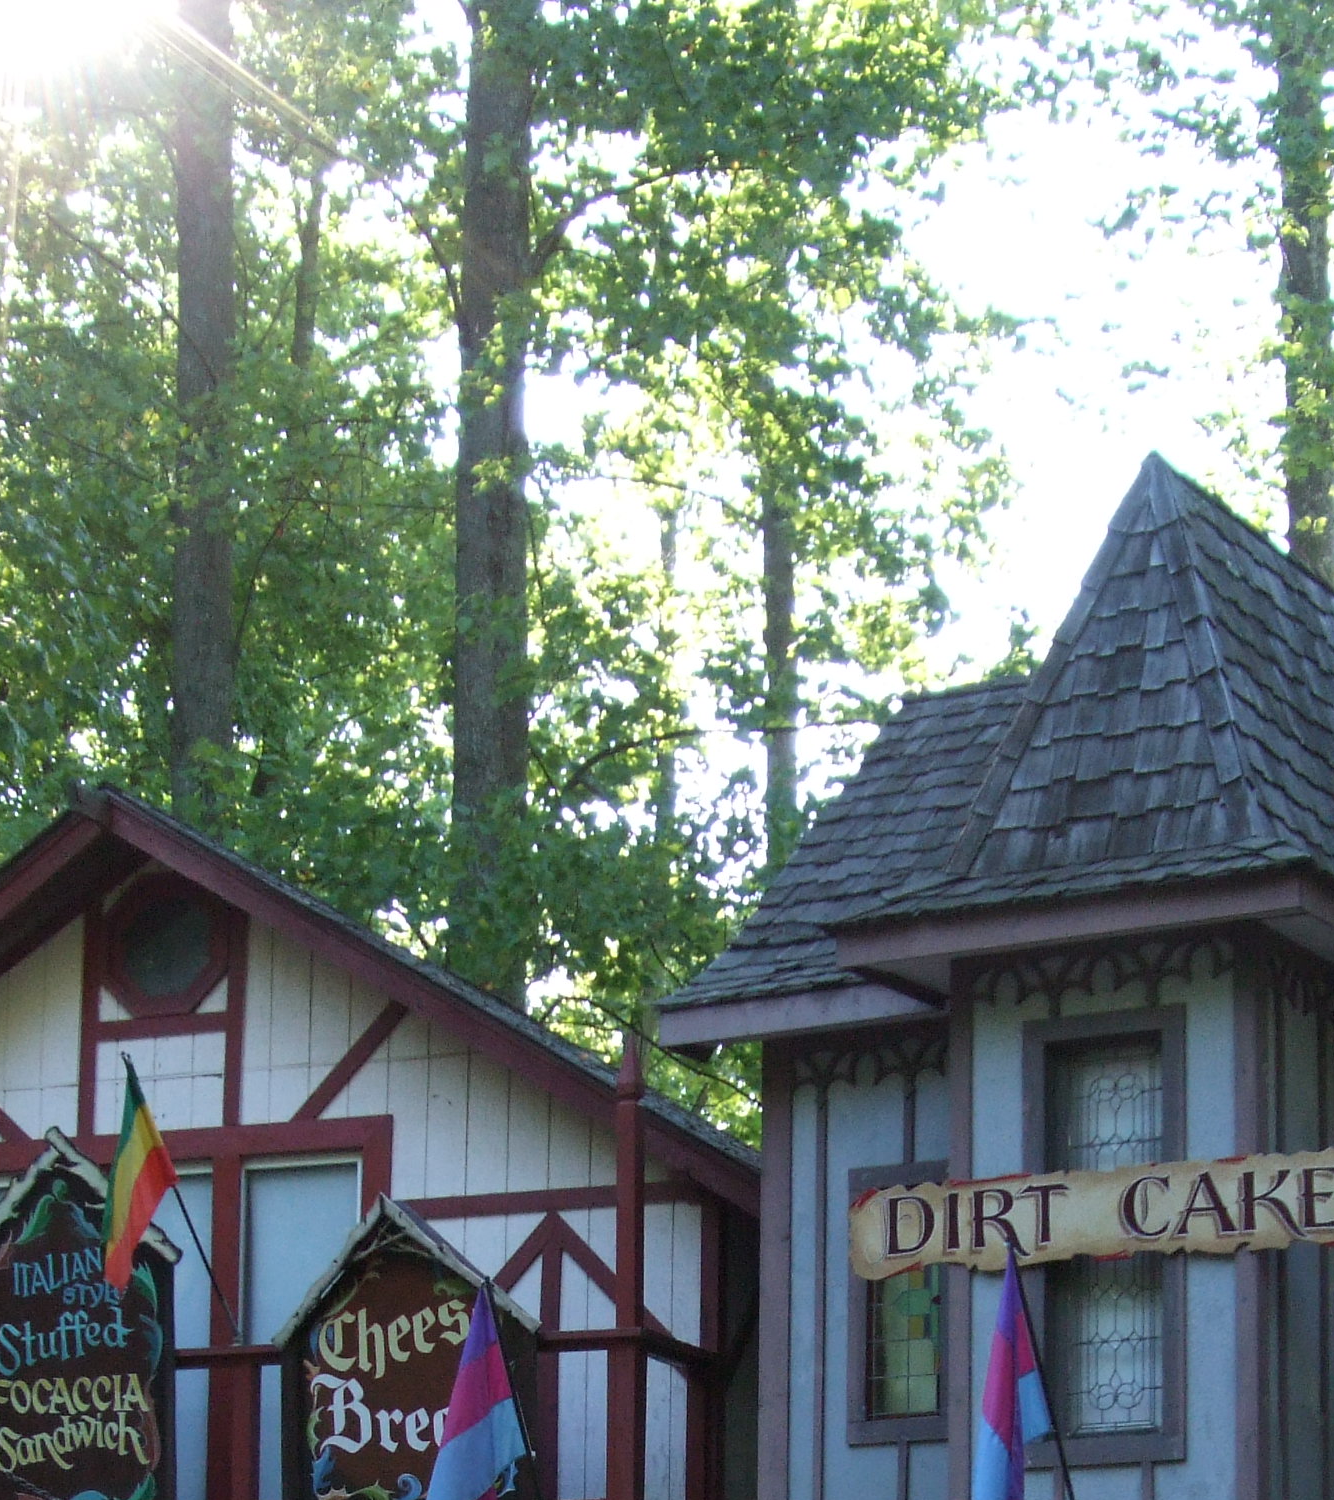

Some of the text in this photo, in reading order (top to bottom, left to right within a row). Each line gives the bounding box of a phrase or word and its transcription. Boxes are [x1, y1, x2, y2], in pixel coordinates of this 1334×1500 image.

[885, 1182, 1069, 1259] DIRT
[12, 1247, 103, 1297] ITALIAN
[318, 1299, 469, 1379] Chees
[310, 1373, 451, 1454] Bre
